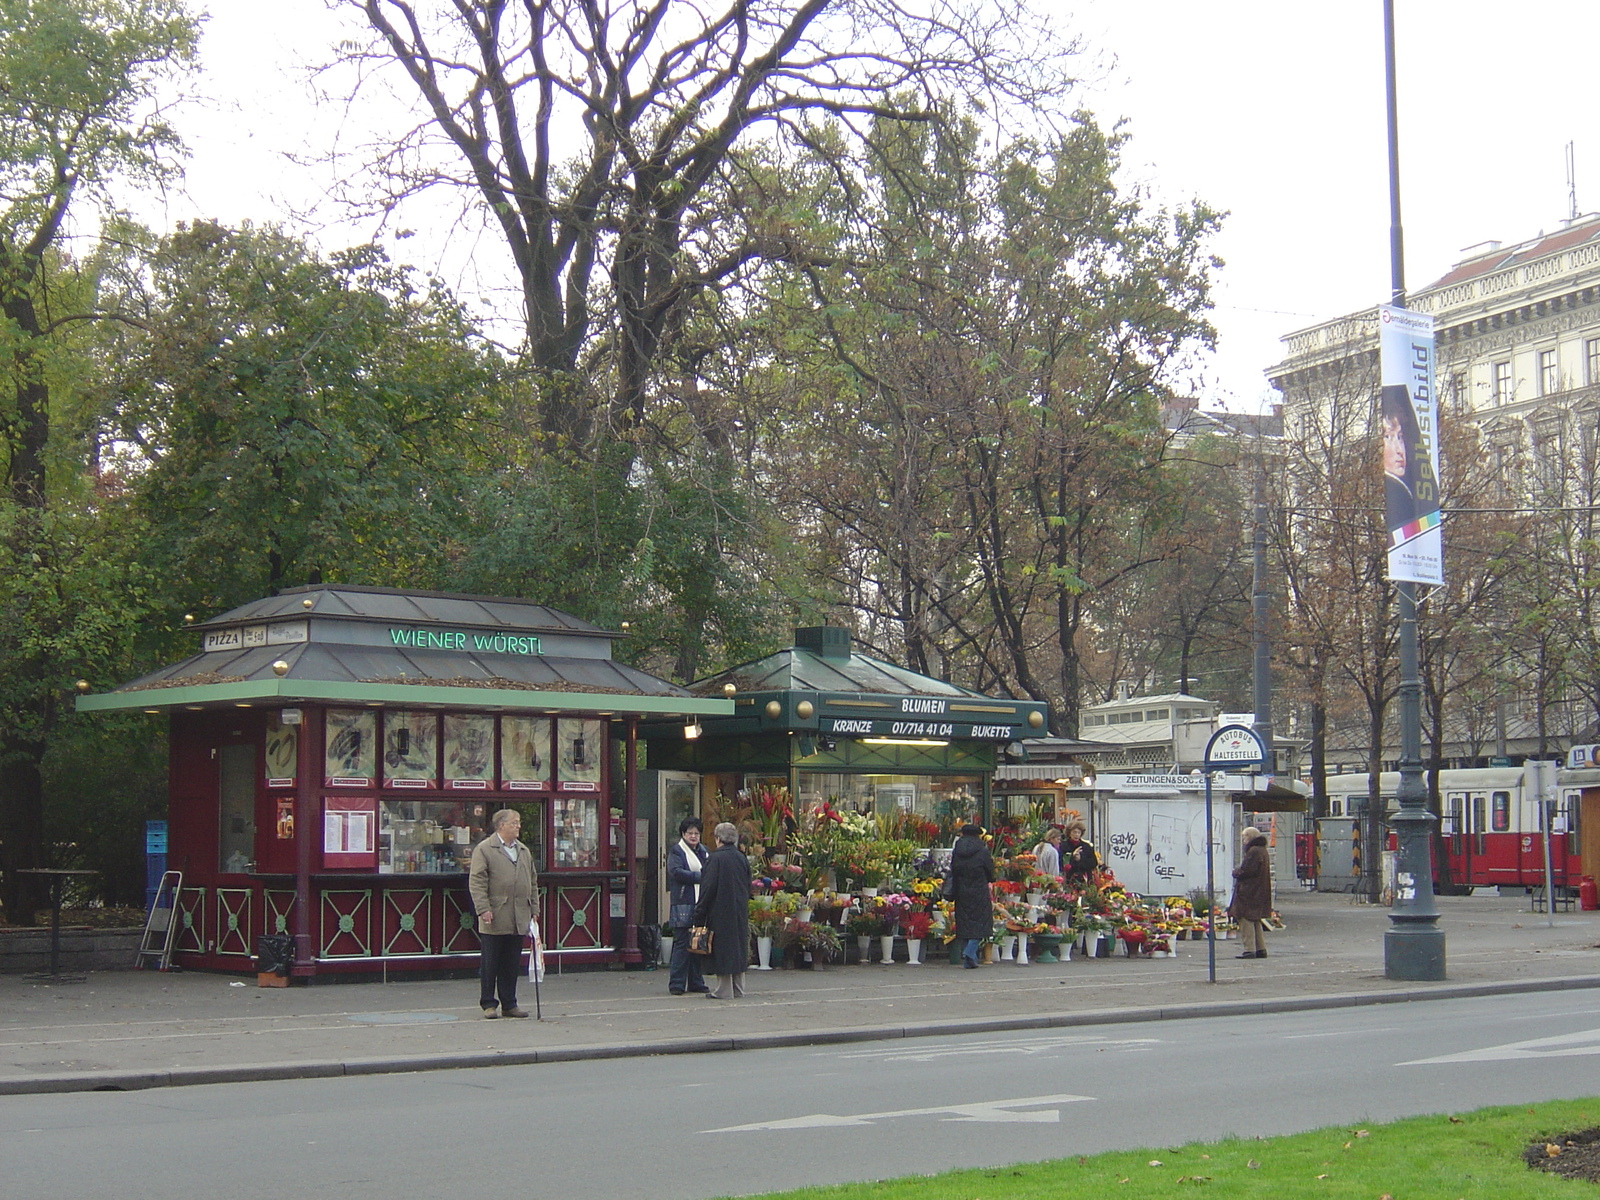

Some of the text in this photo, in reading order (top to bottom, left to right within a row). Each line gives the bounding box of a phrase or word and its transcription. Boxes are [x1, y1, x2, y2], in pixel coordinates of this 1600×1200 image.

[1412, 343, 1433, 501] Selbstbild
[208, 633, 238, 646] PIZZA
[389, 629, 545, 655] WIENER WÜRSTL
[901, 698, 945, 714] BLUMEN
[833, 719, 1011, 739] KRÄNZE 01/714 41 04 BUKETTS
[1220, 730, 1253, 744] AUTOBUS
[1214, 751, 1258, 760] HALTESTELLE
